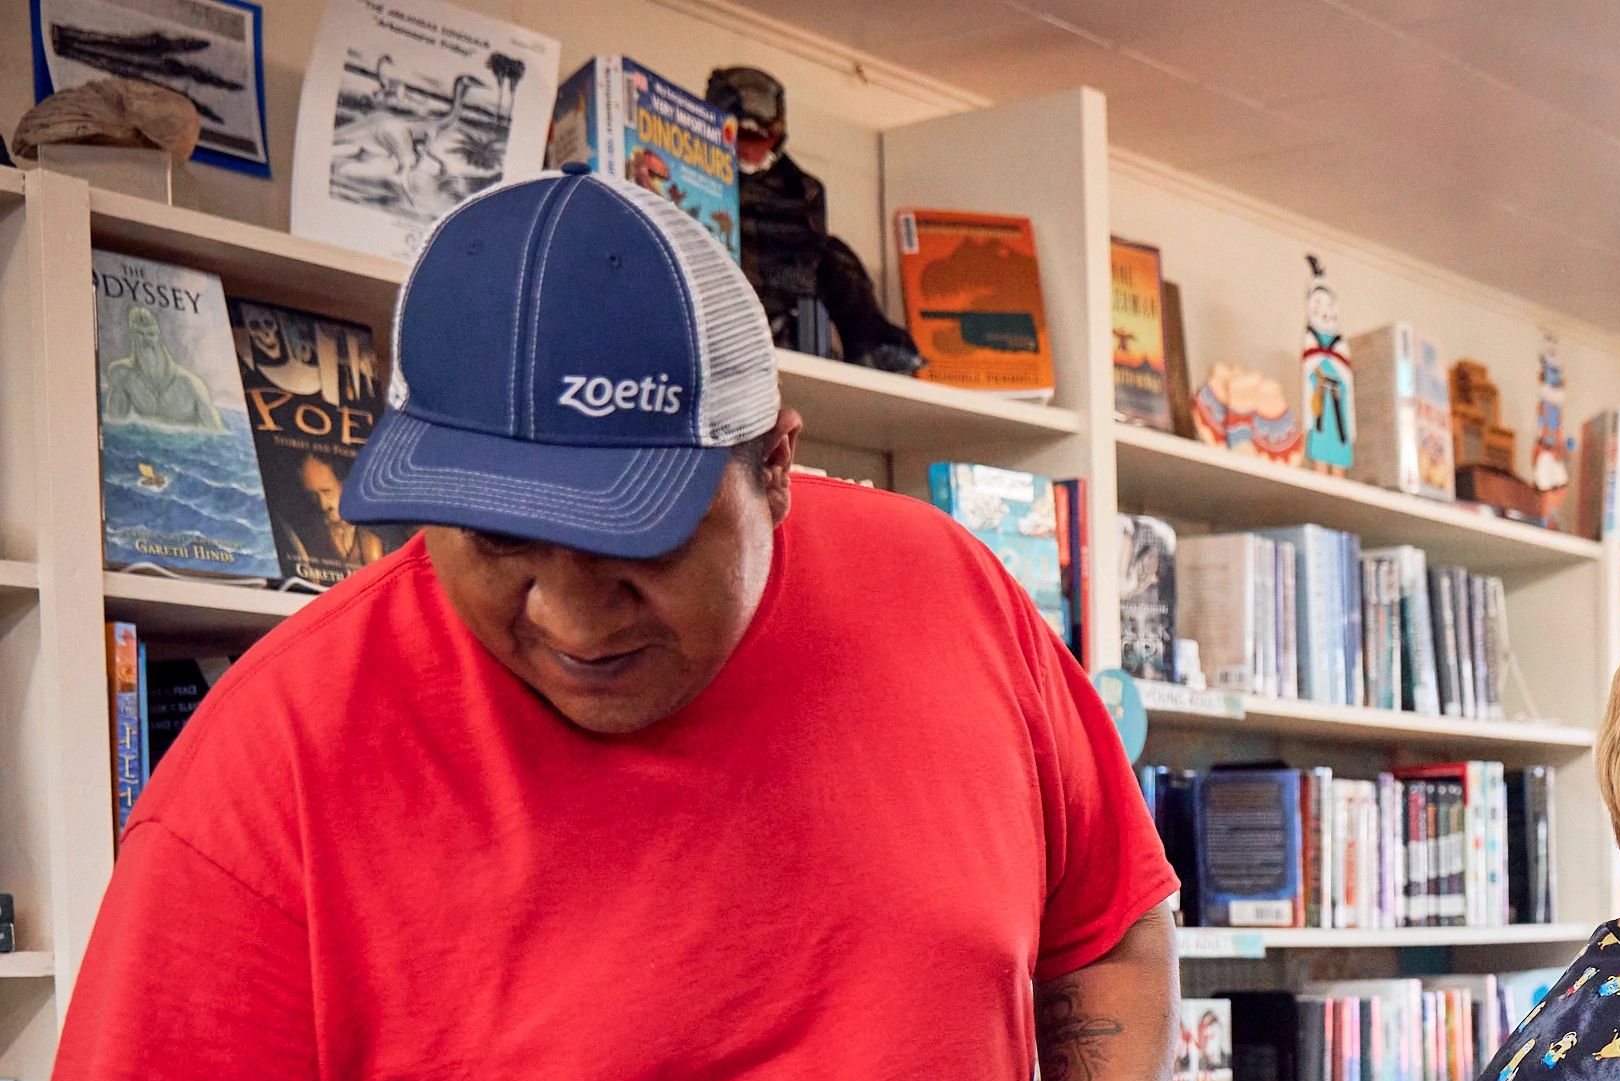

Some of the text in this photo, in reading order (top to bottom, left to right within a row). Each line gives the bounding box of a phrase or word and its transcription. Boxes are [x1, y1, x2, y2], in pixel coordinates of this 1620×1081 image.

[637, 106, 735, 186] DINOSAURS
[121, 262, 145, 278] THE
[245, 388, 374, 446] POE
[559, 373, 683, 417] zoetis
[135, 540, 189, 558] GARETH
[193, 544, 236, 563] HINDS
